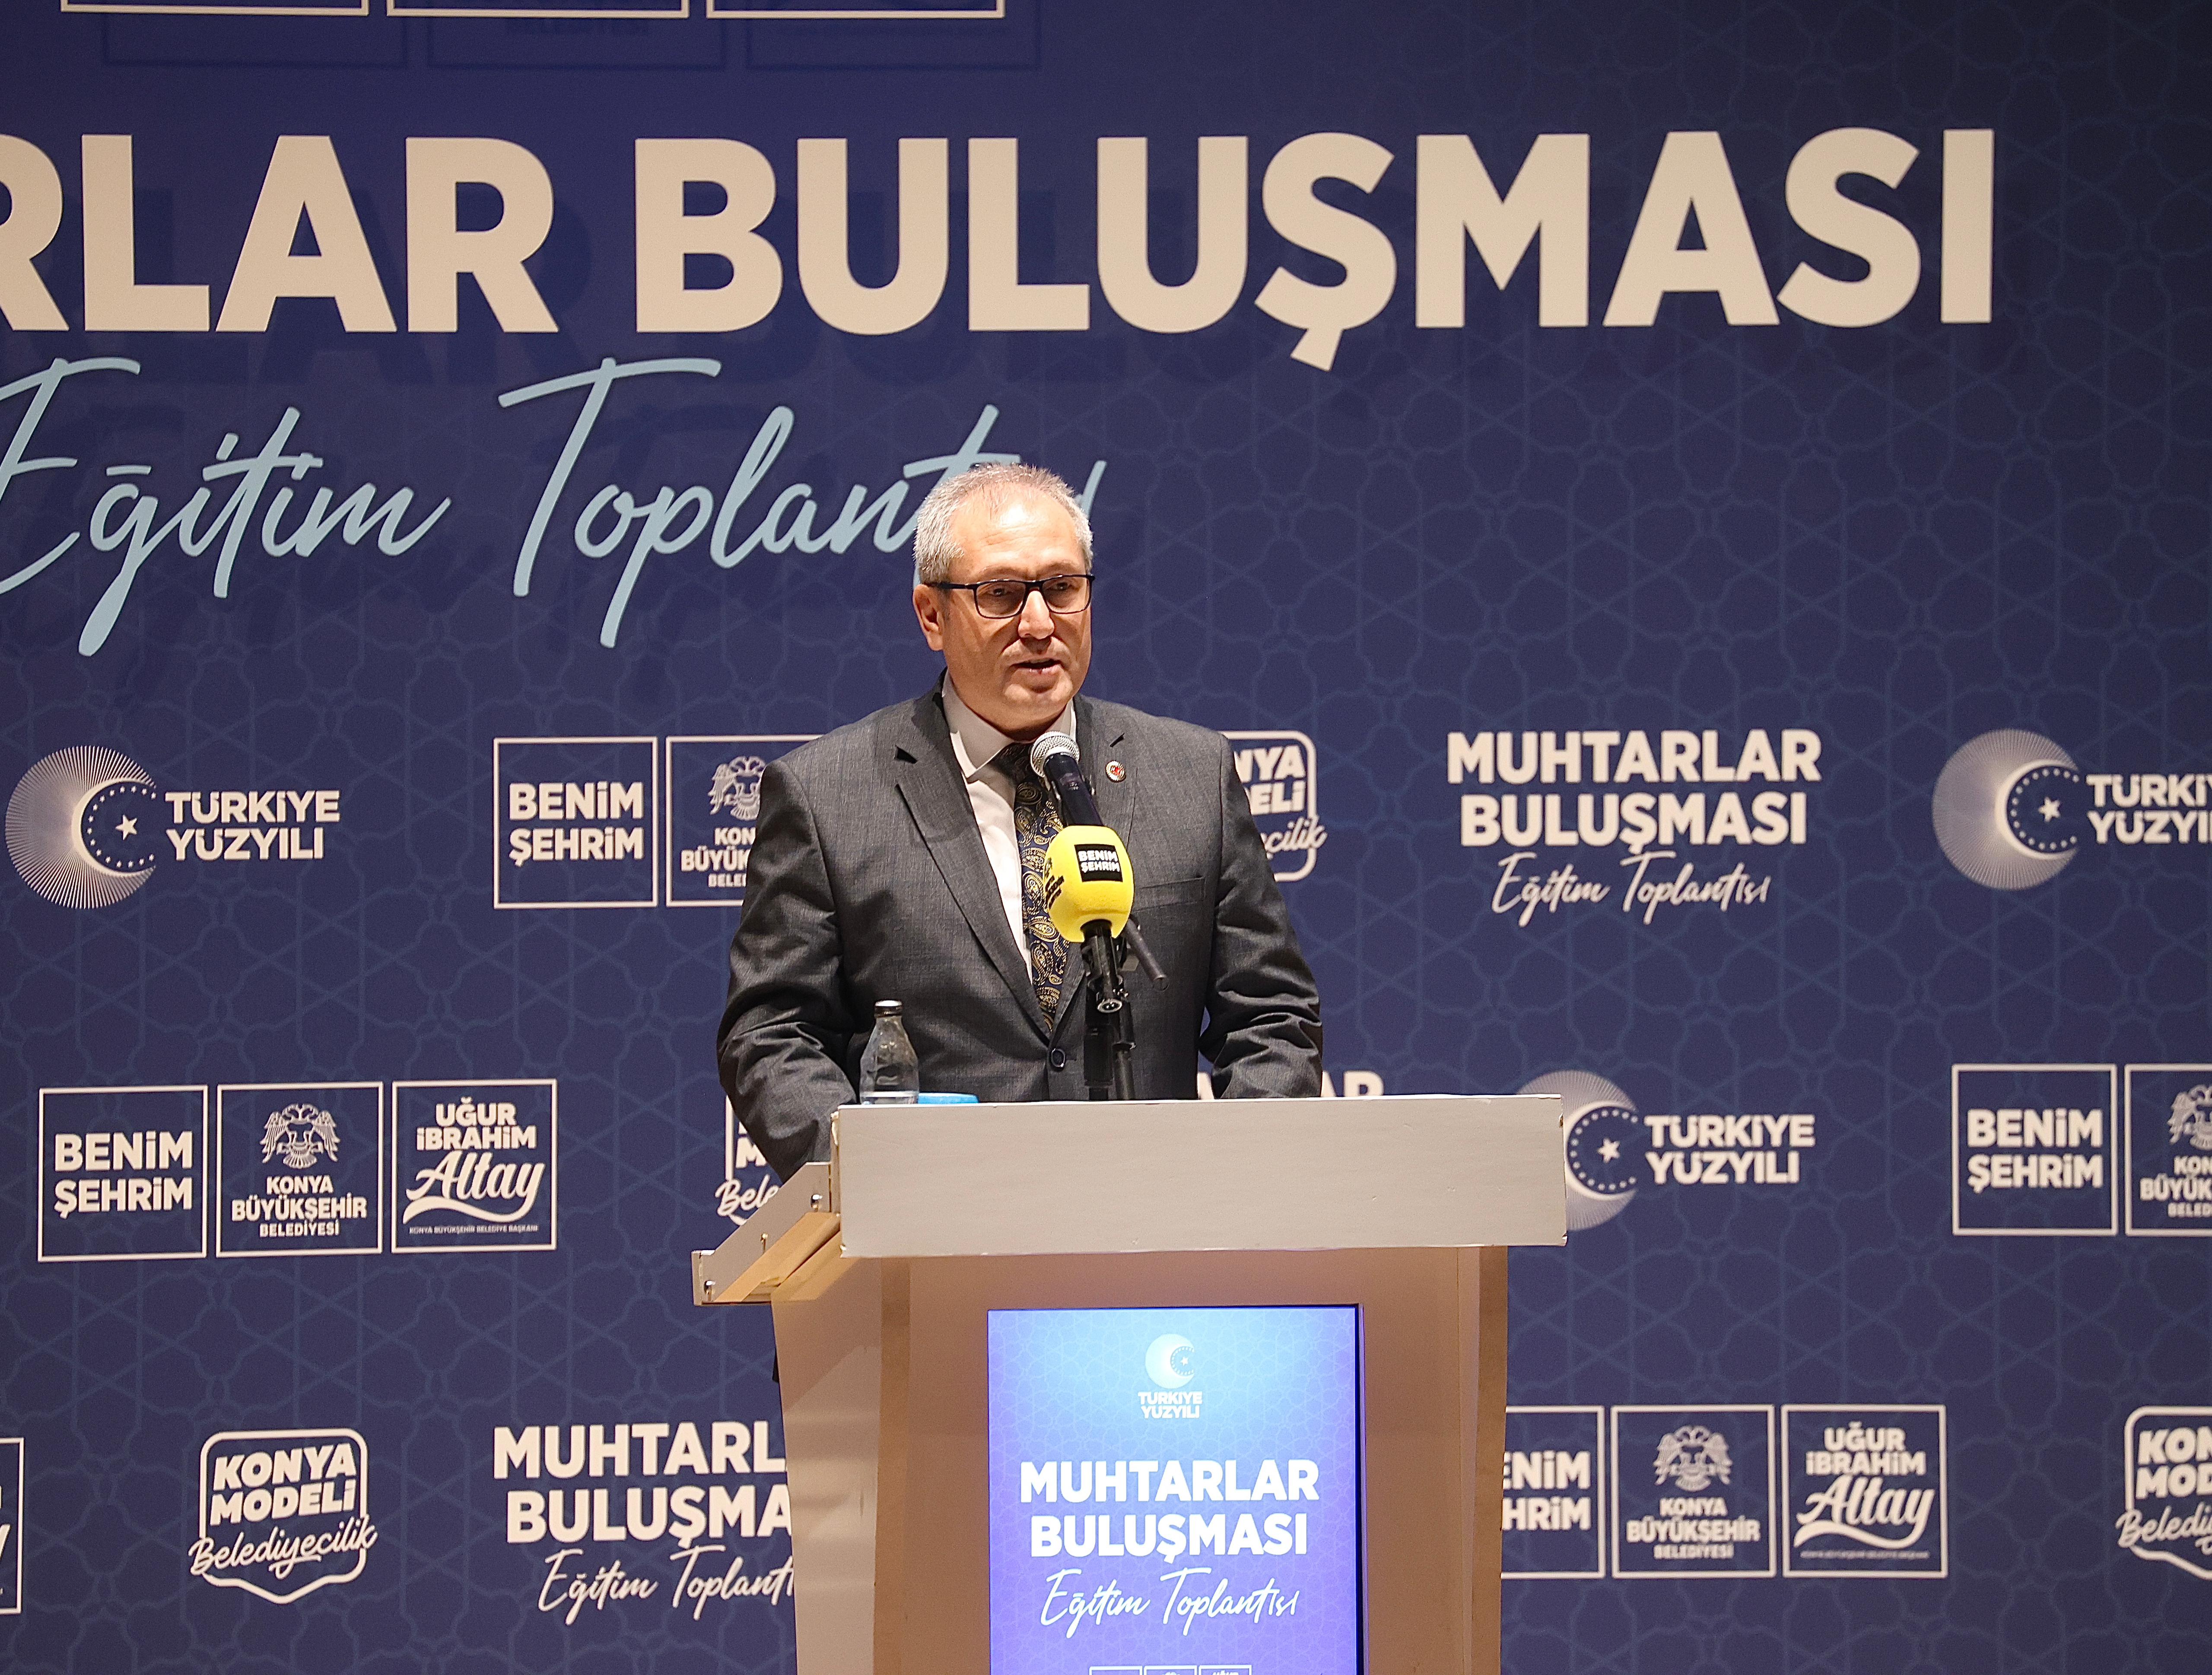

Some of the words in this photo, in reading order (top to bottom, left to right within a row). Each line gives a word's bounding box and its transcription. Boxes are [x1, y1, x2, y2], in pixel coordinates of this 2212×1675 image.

[633, 123, 1998, 374] BULUŞMASI
[1445, 728, 1823, 785] MUHTARLAR
[1458, 790, 1808, 854] BULUŞMASI
[1619, 850, 1772, 927] Toplantısı
[434, 1096, 517, 1128] UĞUR
[231, 1191, 368, 1222] BÜYÜKŞEHİR
[265, 1174, 335, 1196] KONYA
[400, 1148, 546, 1225] Altay
[1823, 1420, 1907, 1451] UĞUR
[211, 1442, 359, 1492] KONYA
[1017, 1456, 1322, 1505] MUHTARLAR
[1625, 1514, 1762, 1545] BÜYÜKŞEHİR
[1658, 1496, 1728, 1518] KONYA
[1793, 1475, 1936, 1550] Altay
[187, 1513, 379, 1581] Belediyecilik
[1028, 1511, 1309, 1566] BULUŞMASI
[1158, 1565, 1300, 1638] Toplantısı
